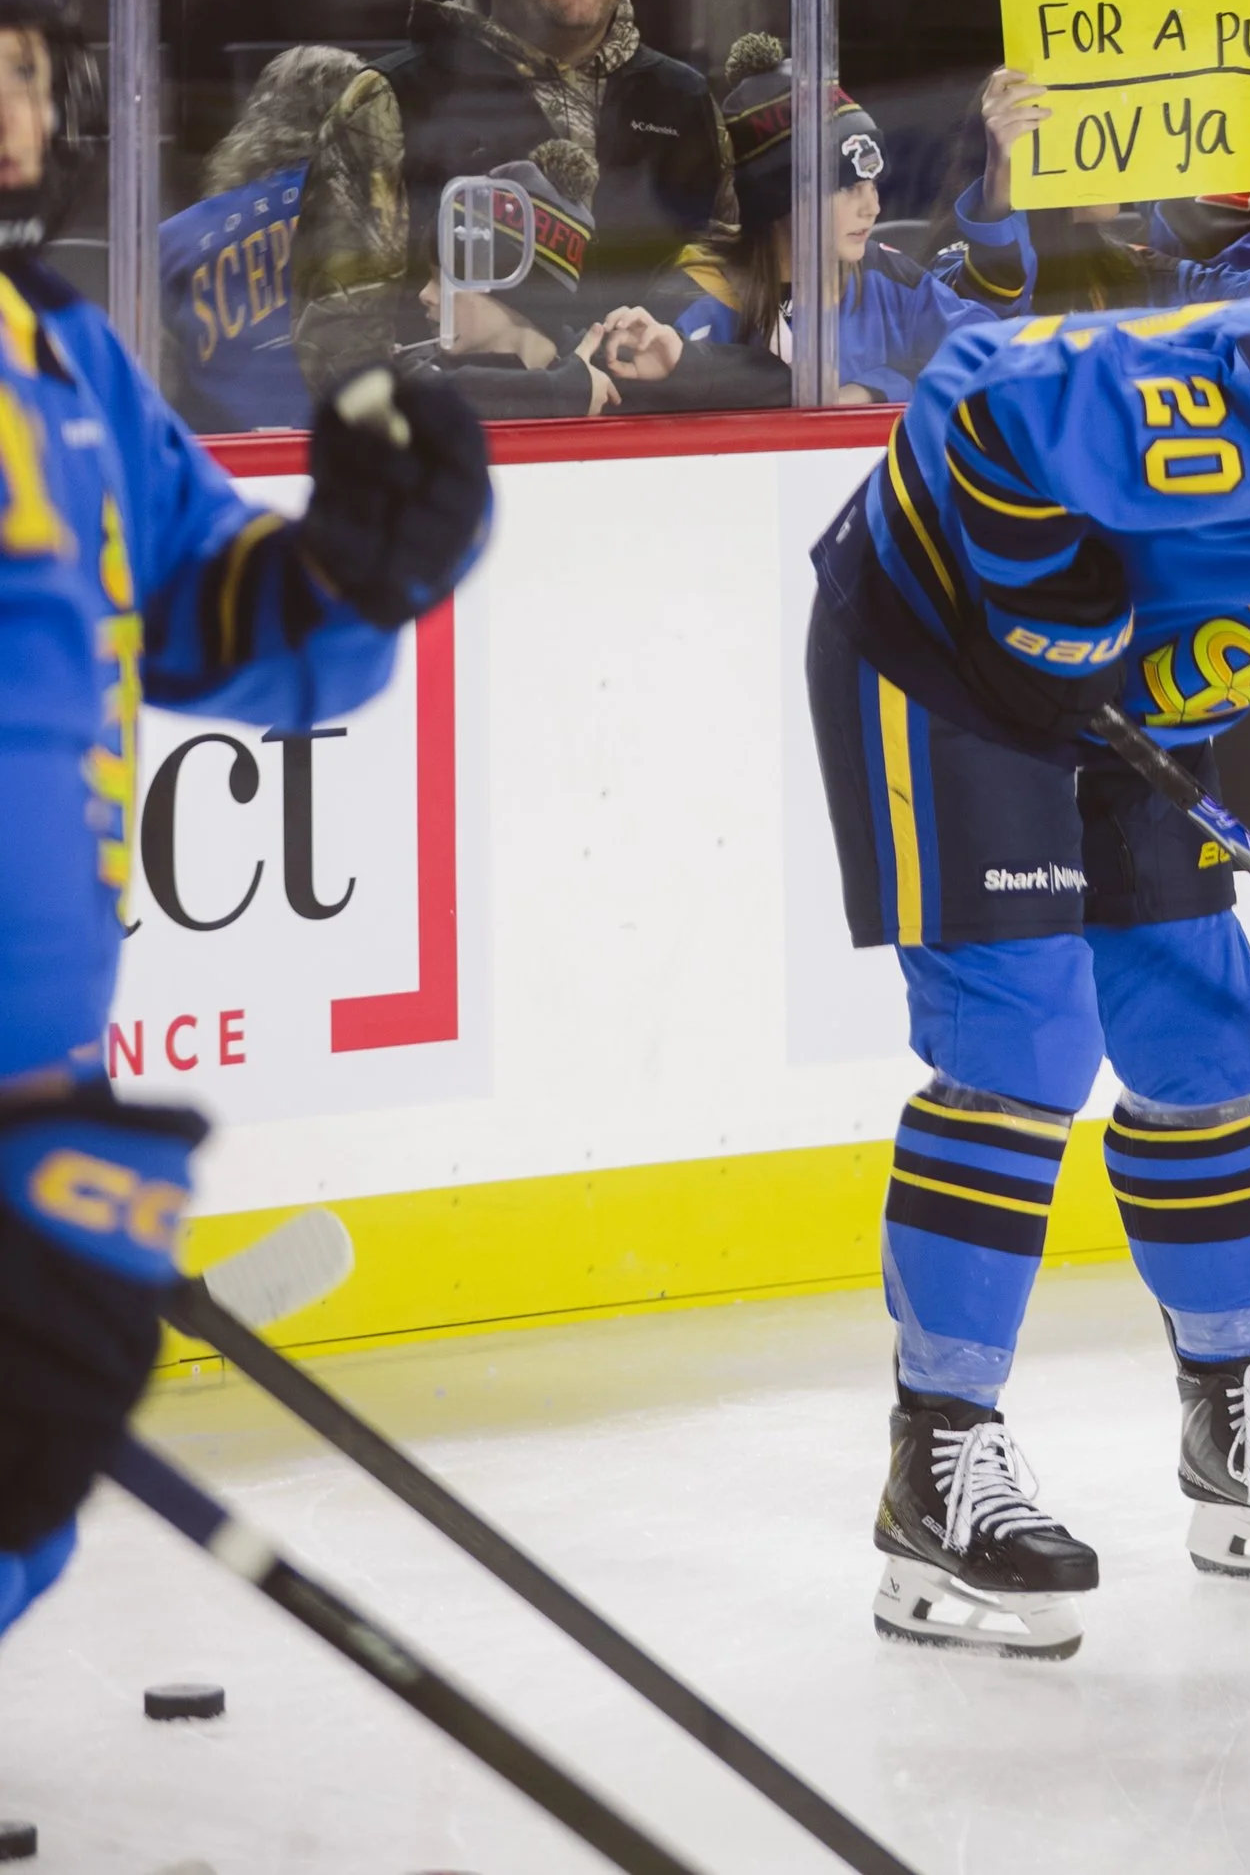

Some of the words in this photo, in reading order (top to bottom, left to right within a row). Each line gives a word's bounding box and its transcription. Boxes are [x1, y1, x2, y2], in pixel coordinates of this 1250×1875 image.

[1038, 3, 1124, 59] FOR
[1153, 9, 1187, 50] A
[1134, 376, 1244, 495] 20
[984, 867, 1049, 892] Shark
